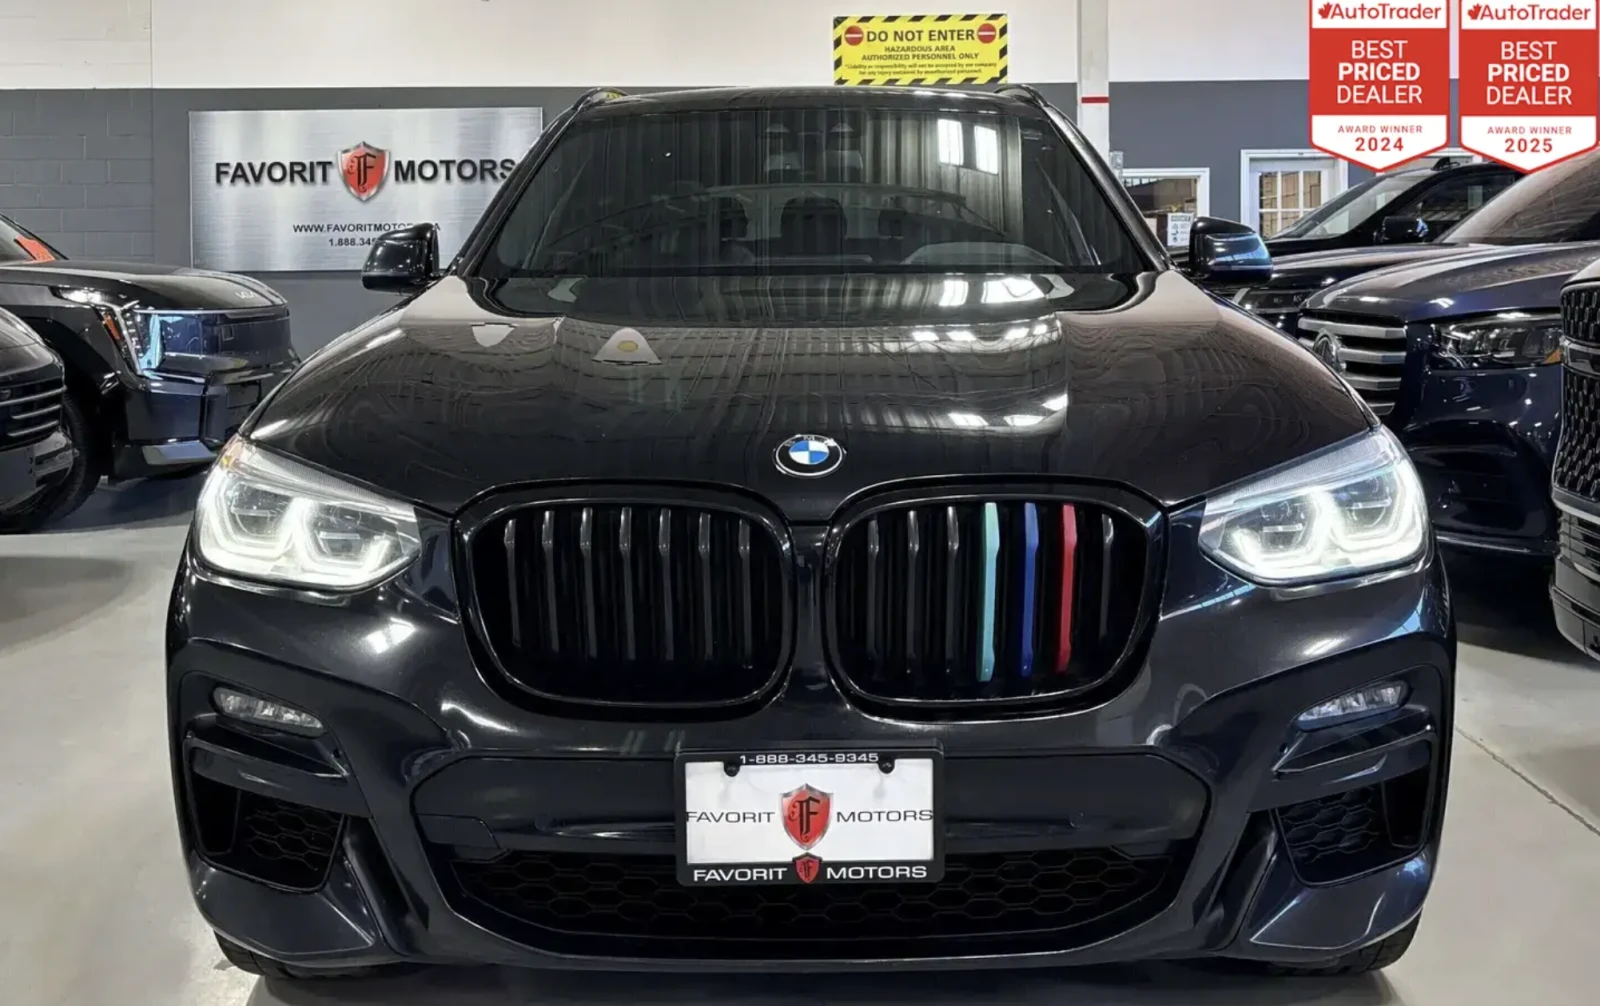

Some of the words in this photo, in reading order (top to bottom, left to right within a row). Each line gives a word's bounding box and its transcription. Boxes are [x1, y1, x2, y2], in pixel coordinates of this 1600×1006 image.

[867, 31, 888, 42] DO
[894, 30, 924, 42] NOT
[928, 29, 975, 41] ENTER
[958, 52, 979, 60] ONLY
[215, 161, 332, 184] FAVORIT
[394, 158, 516, 182] MOTORS
[293, 223, 441, 233] WWW.FAVORITMOTOA
[740, 753, 879, 765] 1-888-345-9345
[686, 811, 775, 823] FAVORIT
[836, 809, 933, 823] MOTORS
[693, 868, 788, 882] FAVORIT
[826, 866, 928, 880] MOTORS
